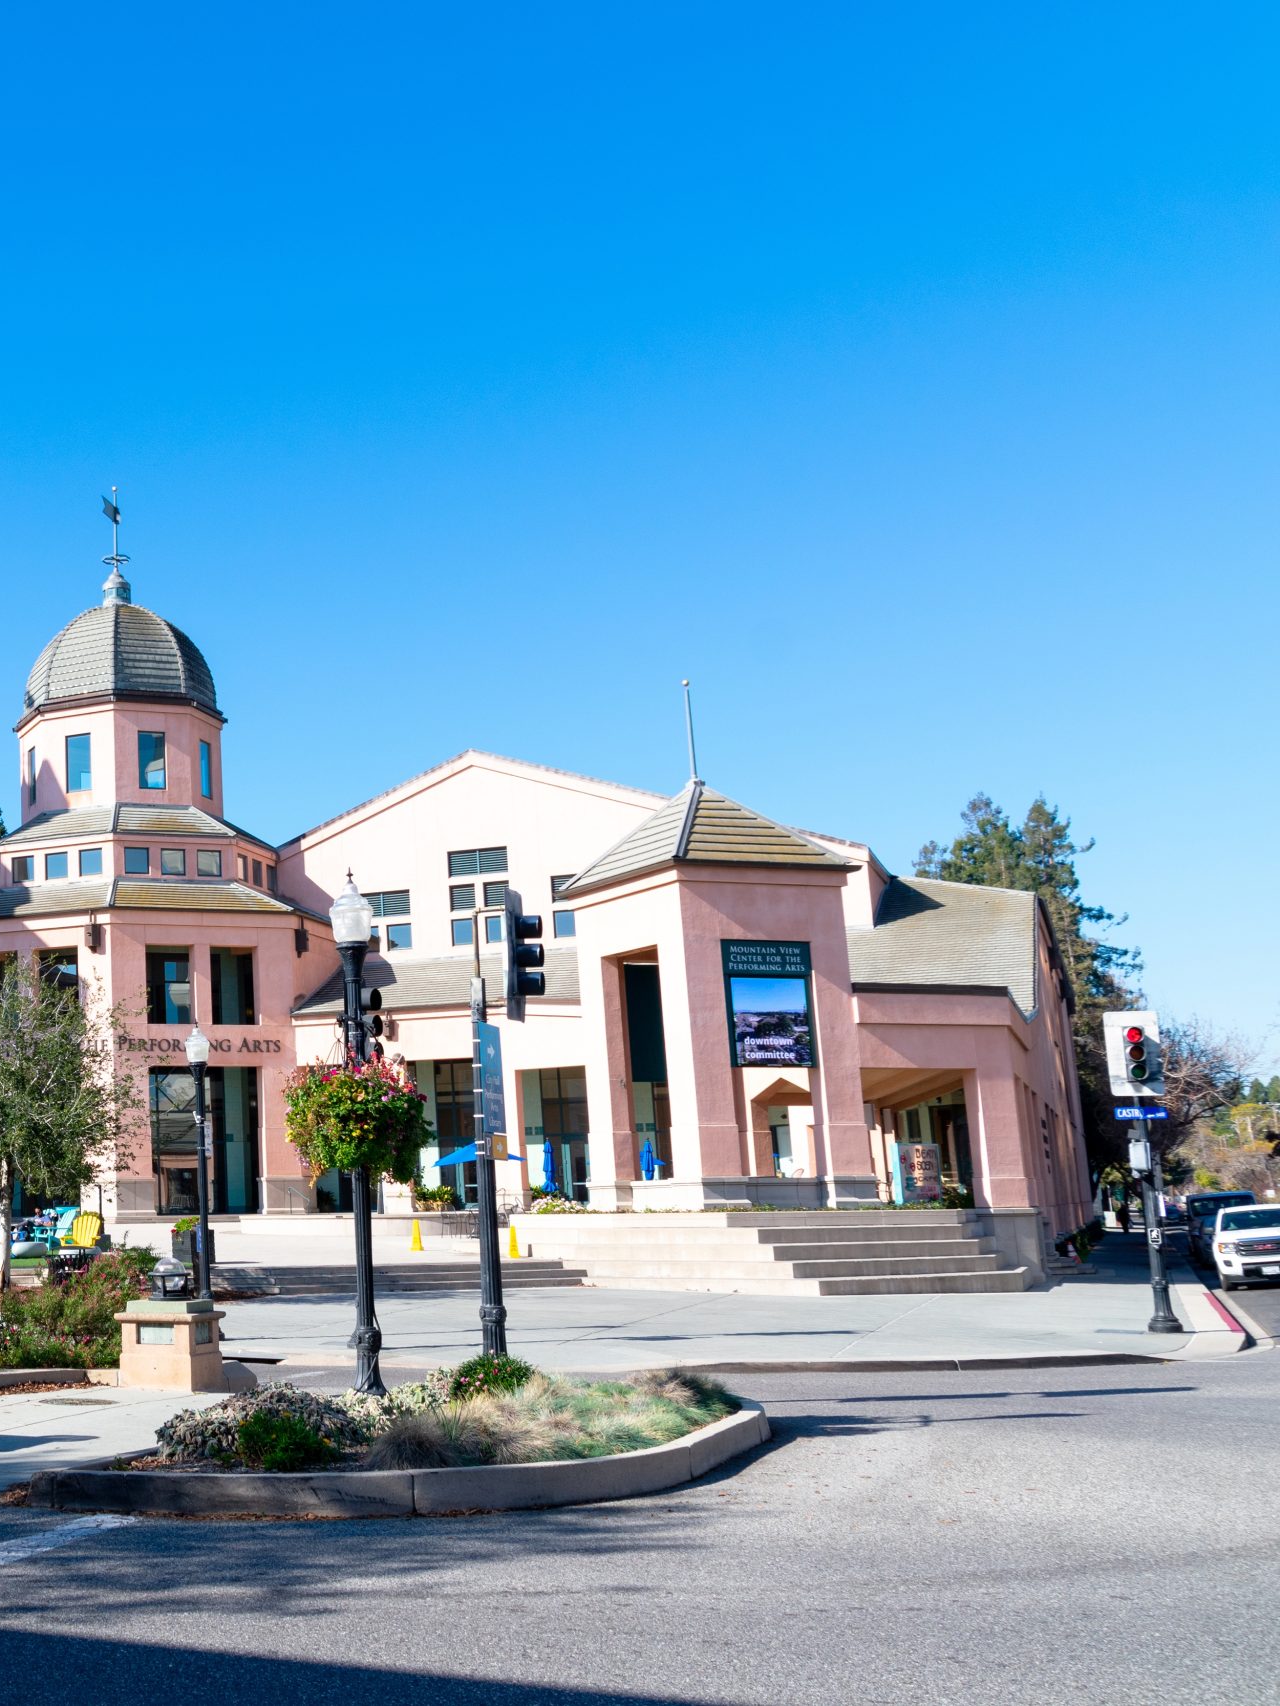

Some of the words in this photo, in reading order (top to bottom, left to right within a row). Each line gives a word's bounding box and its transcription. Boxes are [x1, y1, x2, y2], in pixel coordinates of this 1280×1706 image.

[729, 945, 776, 954] MOUNTAIN
[779, 946, 801, 955] VIEW
[730, 953, 763, 962] CENTER
[728, 962, 782, 971] PERFORMING
[785, 964, 805, 972] ARTS
[117, 1036, 232, 1053] PERFORNG
[237, 1037, 281, 1053] ARTS
[744, 1036, 793, 1046] downtown
[745, 1050, 796, 1059] committee
